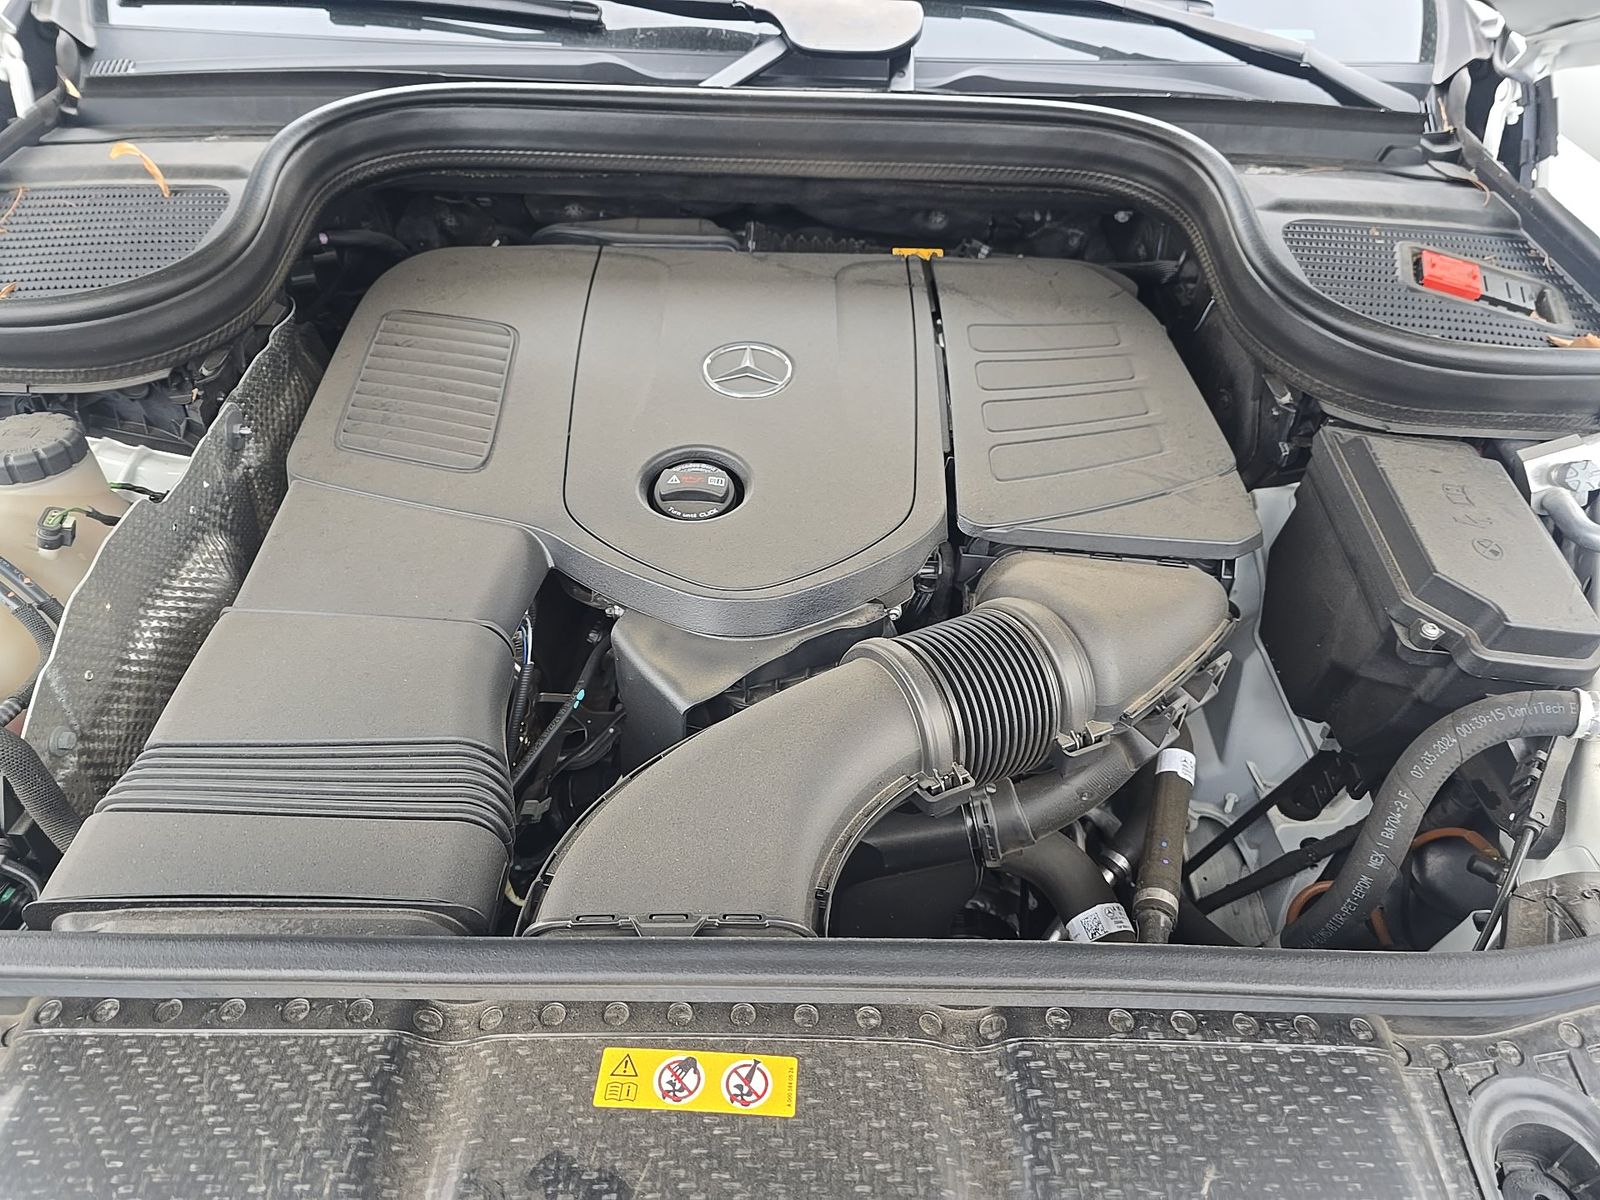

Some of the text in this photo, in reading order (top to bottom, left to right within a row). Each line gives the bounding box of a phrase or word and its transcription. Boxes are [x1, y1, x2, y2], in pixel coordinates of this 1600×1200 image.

[668, 506, 682, 517] Turn
[699, 507, 719, 518] CLICK
[1367, 850, 1386, 870] MEX
[1380, 800, 1409, 841] BA704-2
[1410, 734, 1457, 780] 07.03.2024
[1455, 708, 1506, 738] 00:39:15
[1507, 701, 1565, 718] ContiTech
